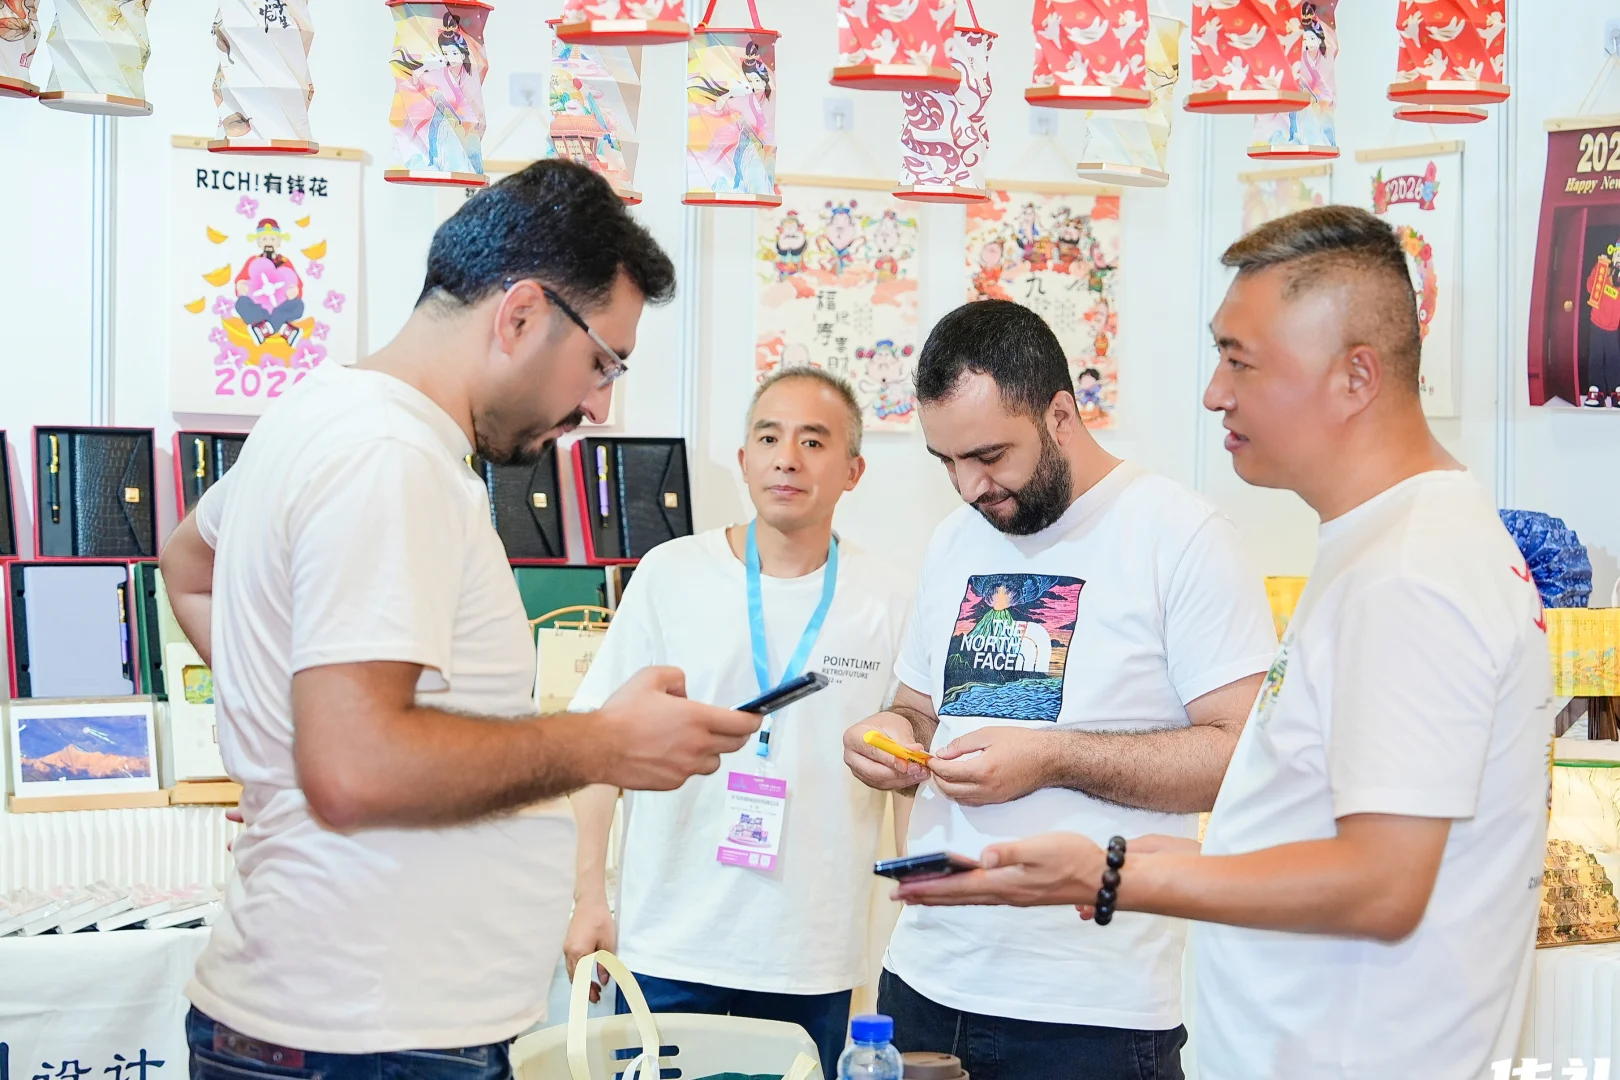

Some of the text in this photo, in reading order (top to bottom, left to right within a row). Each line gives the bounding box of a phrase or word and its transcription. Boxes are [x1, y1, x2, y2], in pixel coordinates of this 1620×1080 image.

[1391, 176, 1423, 202] 2026
[1564, 177, 1599, 194] Happy
[993, 619, 1027, 638] THE
[960, 634, 1022, 655] NORTH
[823, 655, 881, 671] POINTLIMIT
[973, 651, 1017, 671] FACE
